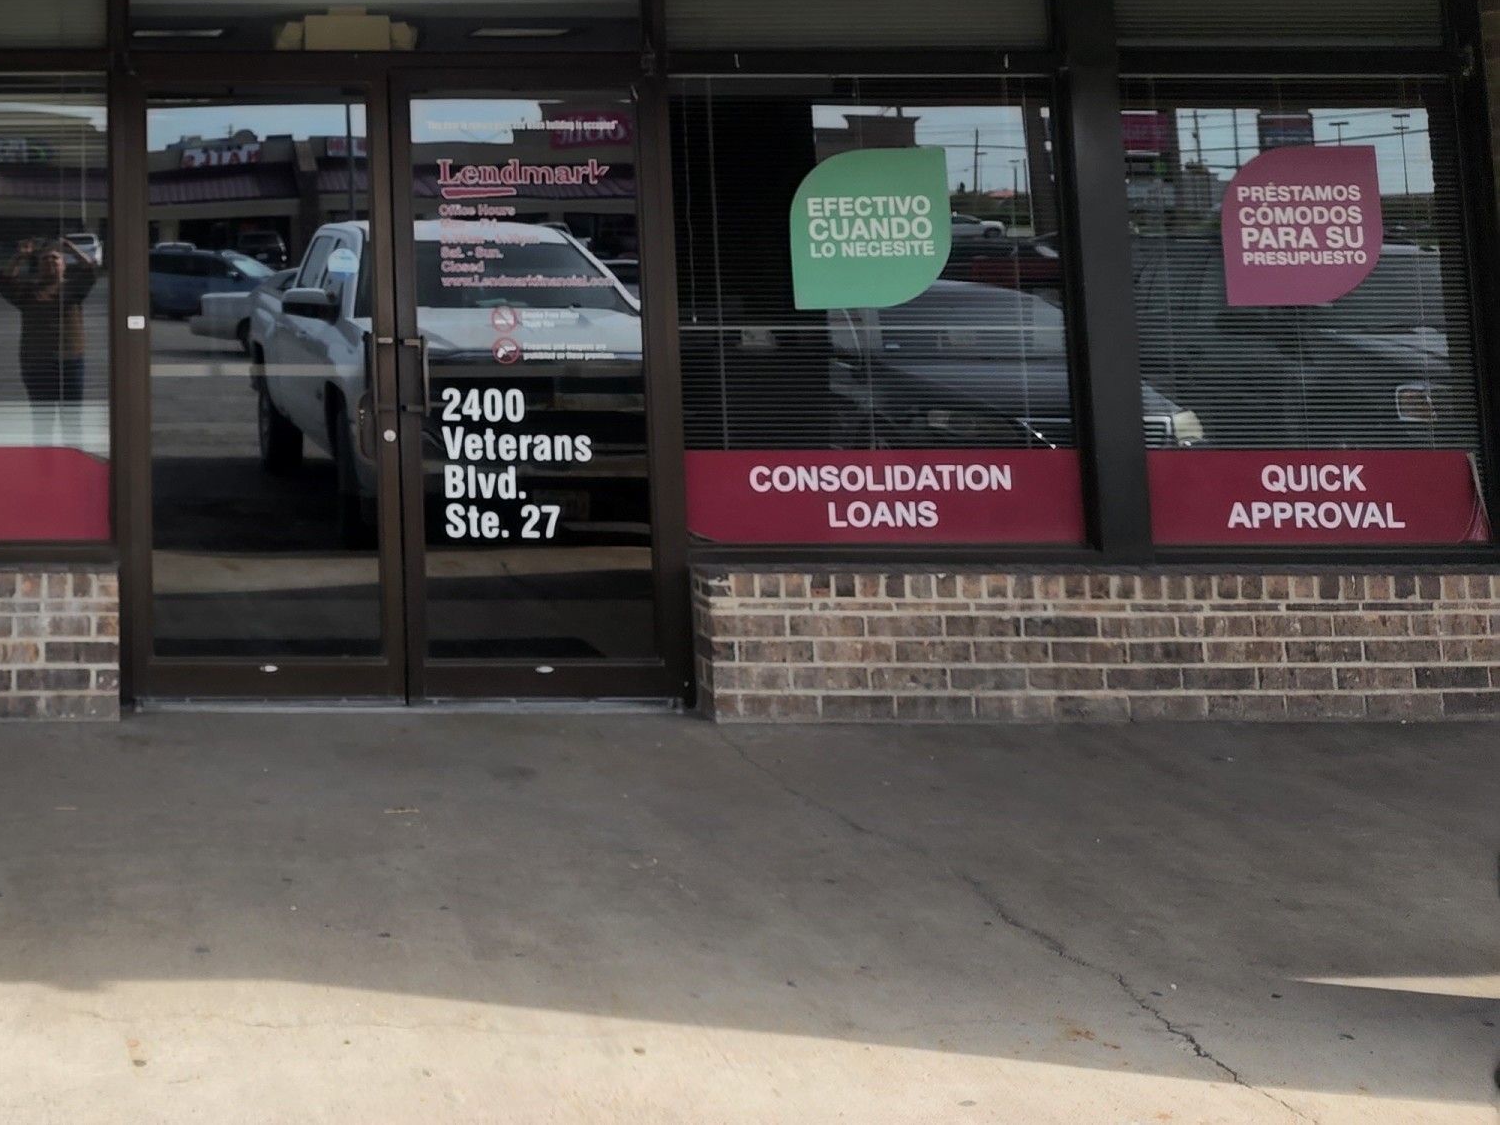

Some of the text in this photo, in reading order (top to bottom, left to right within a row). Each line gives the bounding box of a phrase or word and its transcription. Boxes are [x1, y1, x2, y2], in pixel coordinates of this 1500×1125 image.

[436, 159, 610, 185] Lendmark
[1237, 182, 1362, 203] PRÉSTAMOS
[438, 204, 516, 217] Office Hours
[807, 196, 931, 218] EFECTIVO
[1239, 202, 1363, 226] CÓMODOS
[809, 218, 933, 242] CUANDO
[1242, 226, 1365, 250] PARA SU
[440, 246, 465, 259] Sat.
[474, 246, 504, 259] Sun.
[810, 240, 936, 259] LO NECESITE
[1242, 249, 1368, 267] PRESUPUESTO
[441, 261, 485, 273] Closed
[441, 387, 525, 423] 2400
[441, 425, 593, 462] Veterans
[444, 465, 527, 500] Blvd.
[749, 463, 1013, 494] CONSOLIDATION
[1261, 464, 1366, 495] QUICK
[445, 503, 561, 539] Ste. 27
[828, 500, 939, 530] LOANS
[1228, 501, 1406, 530] APPROVAL
